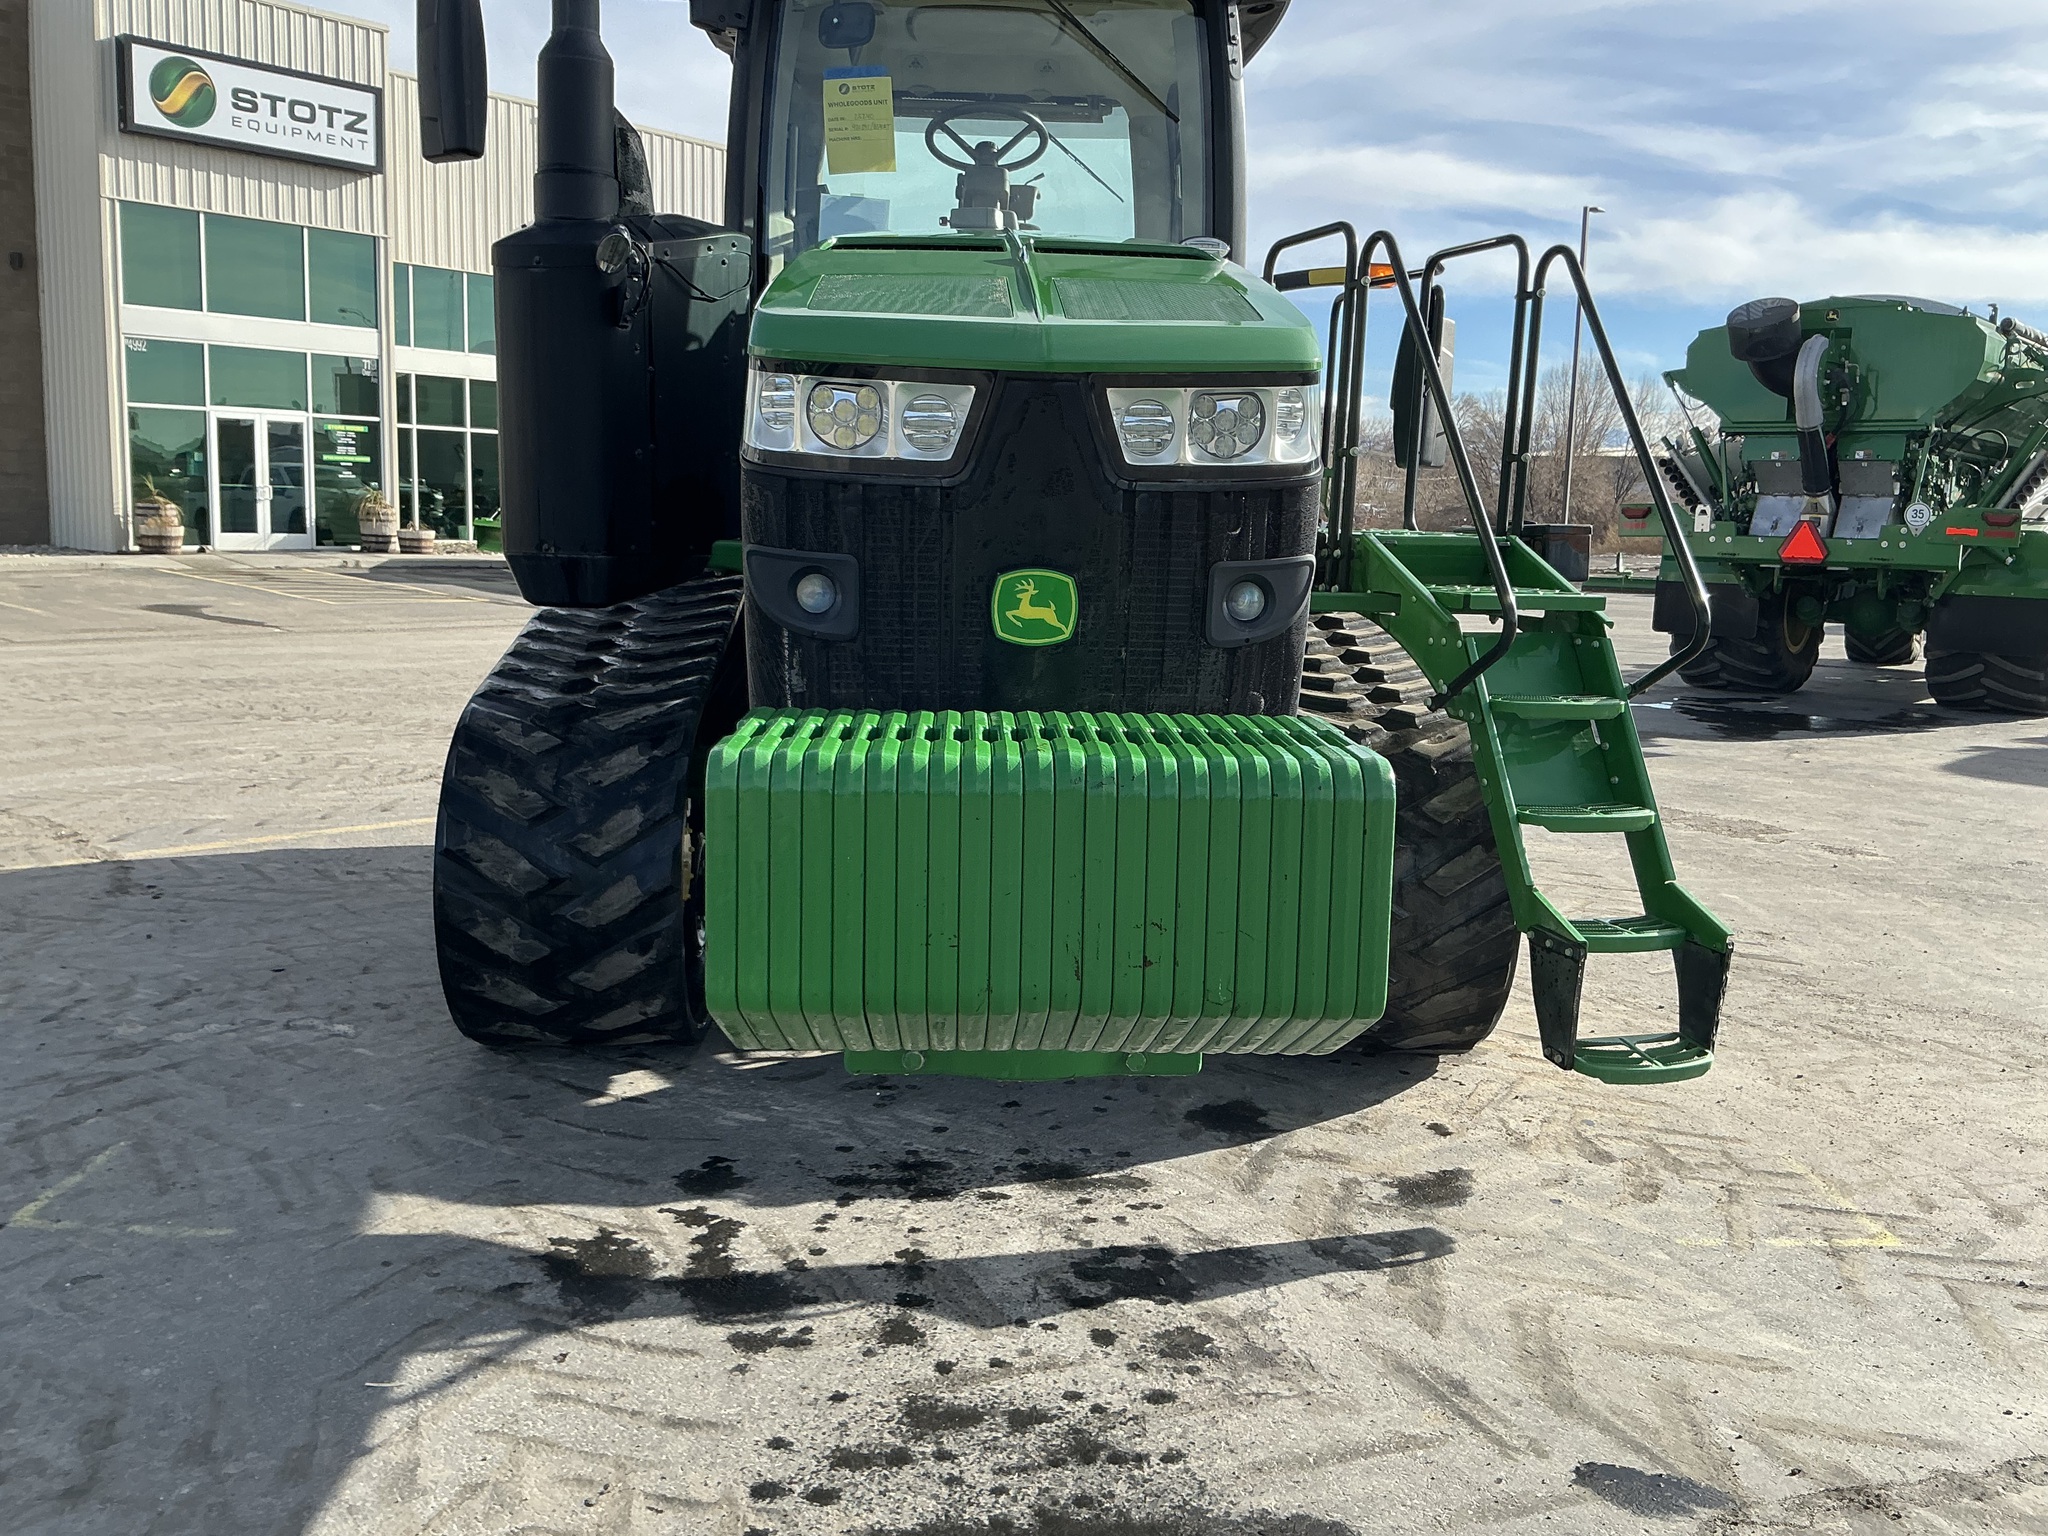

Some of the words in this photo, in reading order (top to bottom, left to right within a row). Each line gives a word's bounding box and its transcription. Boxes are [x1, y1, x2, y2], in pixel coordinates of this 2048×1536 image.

[231, 87, 368, 135] STOTZ
[231, 116, 369, 150] EQUIPMENT
[1911, 509, 1924, 519] 35
